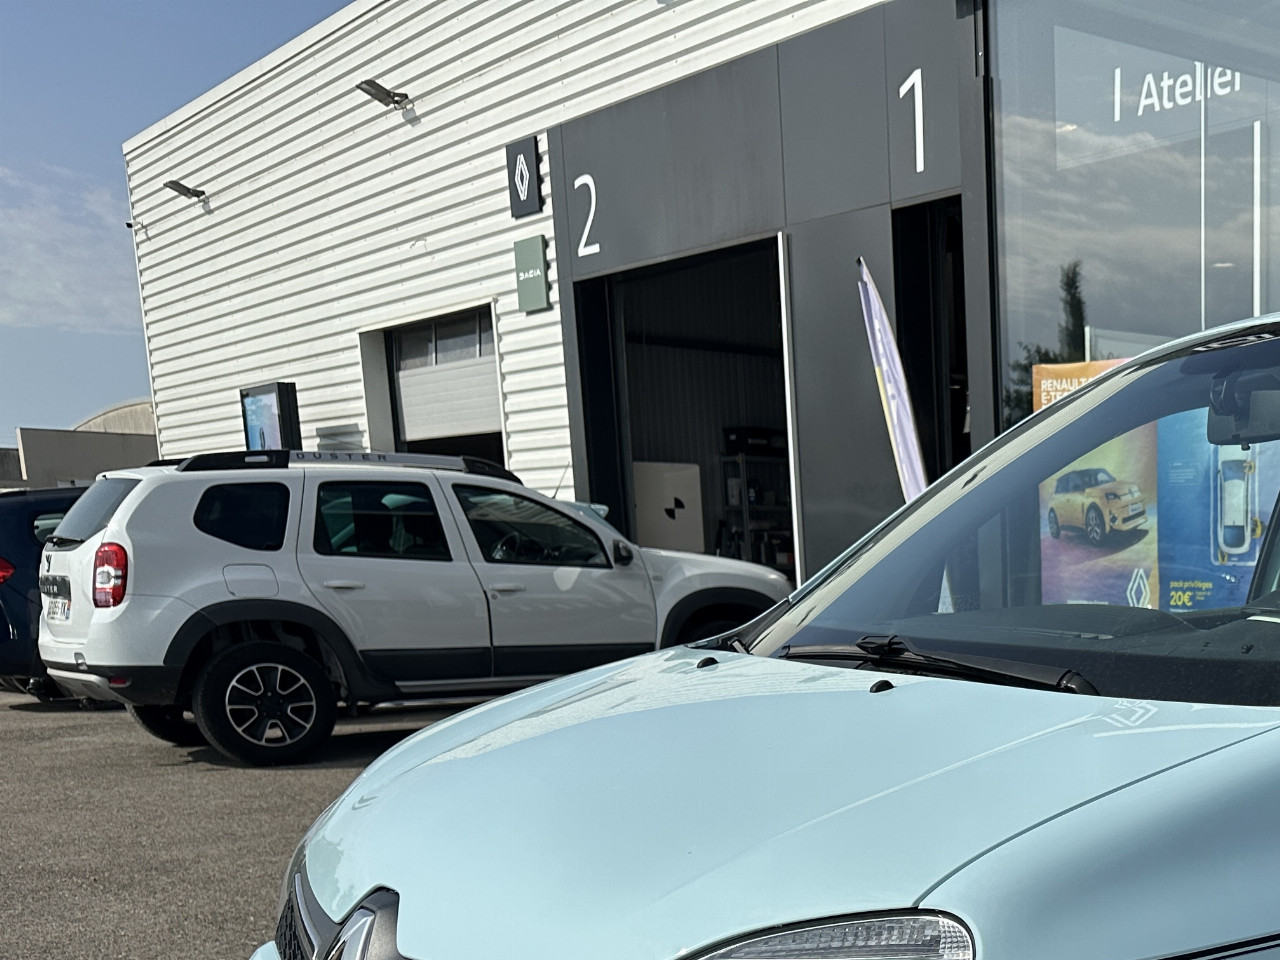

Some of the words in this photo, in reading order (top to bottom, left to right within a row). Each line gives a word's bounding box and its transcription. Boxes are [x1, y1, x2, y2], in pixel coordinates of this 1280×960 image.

[899, 68, 925, 173] 1
[573, 173, 601, 258] 2
[518, 268, 542, 281] DACIA
[1041, 377, 1088, 391] RENAULT
[296, 452, 388, 462] DUSTER
